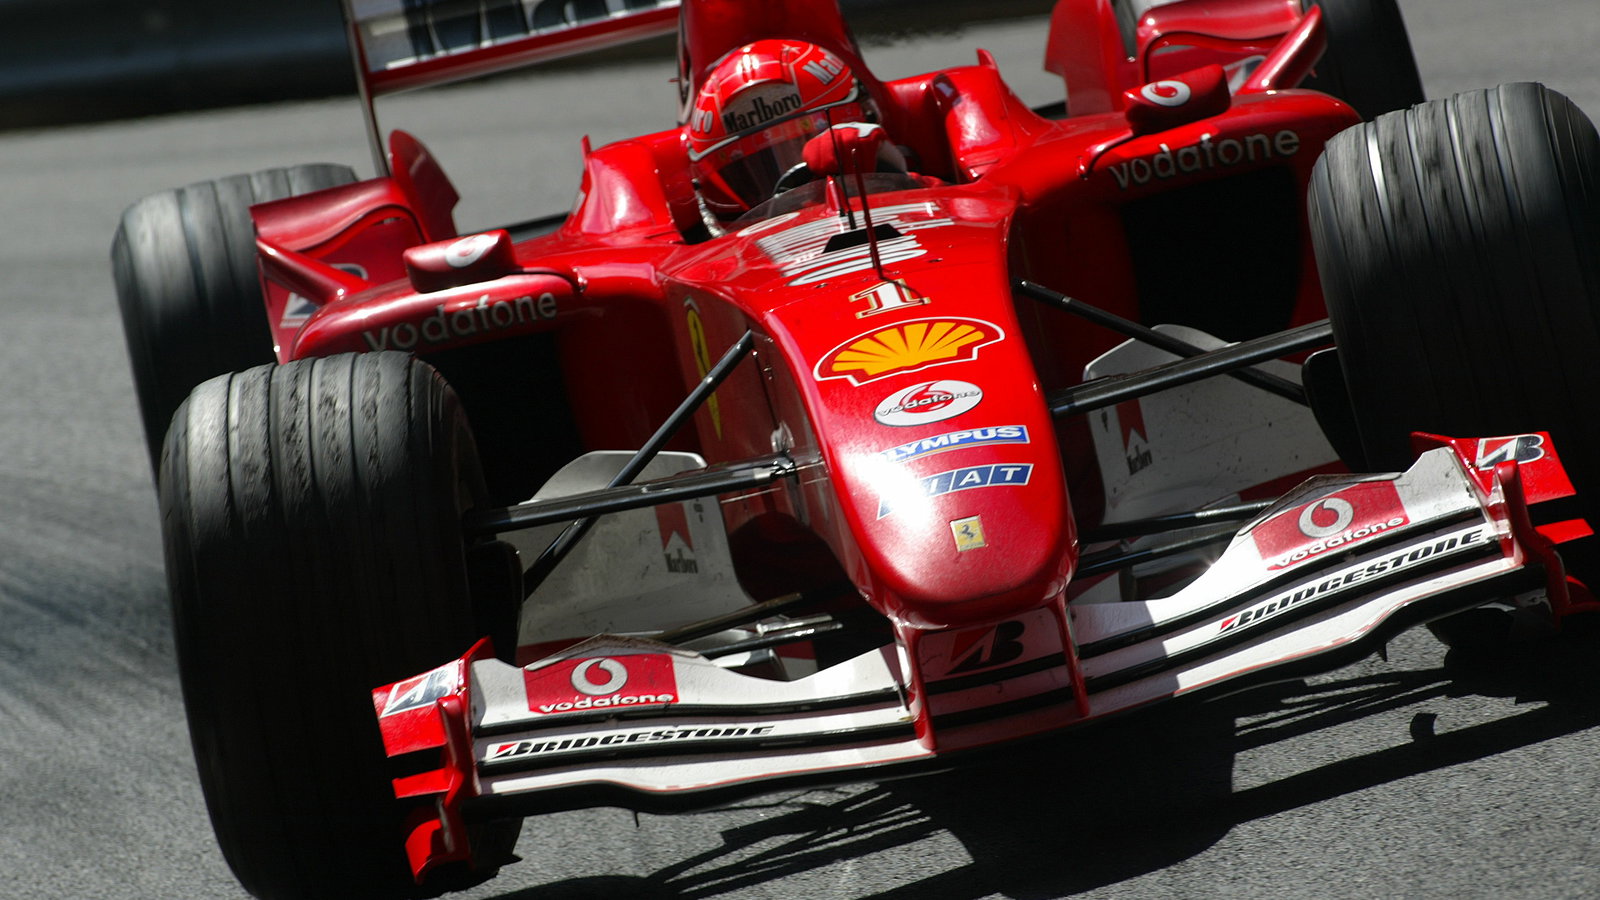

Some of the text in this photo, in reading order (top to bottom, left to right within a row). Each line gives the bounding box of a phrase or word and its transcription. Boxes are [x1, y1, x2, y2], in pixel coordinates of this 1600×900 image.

[723, 93, 801, 132] Marlboro
[1108, 129, 1300, 190] vodafone
[849, 277, 932, 320] 1
[363, 291, 558, 351] vodafone
[878, 390, 981, 417] vodafone
[880, 426, 1023, 463] LYMPUS
[928, 467, 1021, 494] IAT
[1268, 516, 1405, 569] vodafone
[1219, 528, 1486, 632] BRIDGESTONE
[537, 692, 676, 714] vodafone
[491, 725, 775, 759] BRIDGESTONE
